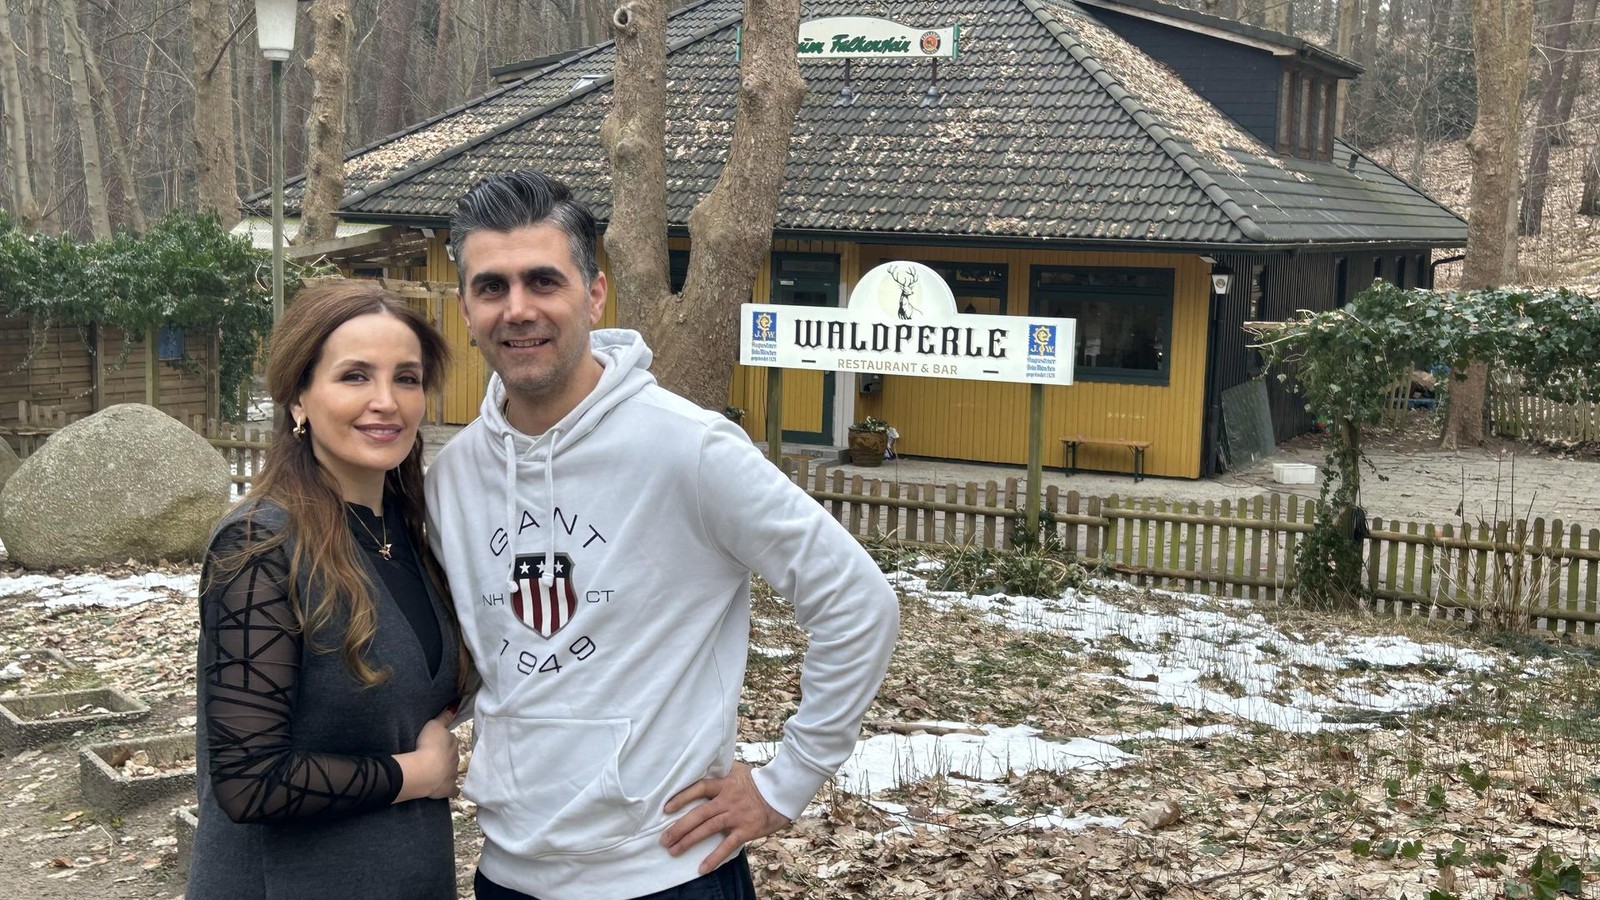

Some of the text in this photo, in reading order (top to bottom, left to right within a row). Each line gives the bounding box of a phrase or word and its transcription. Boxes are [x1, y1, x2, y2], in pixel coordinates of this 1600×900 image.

[794, 319, 1009, 358] WALDPERLE
[837, 359, 958, 375] RESTAURANT & BAR
[489, 506, 607, 557] GANT
[482, 593, 505, 607] NH
[585, 590, 615, 603] CT
[500, 635, 596, 676] 1949
